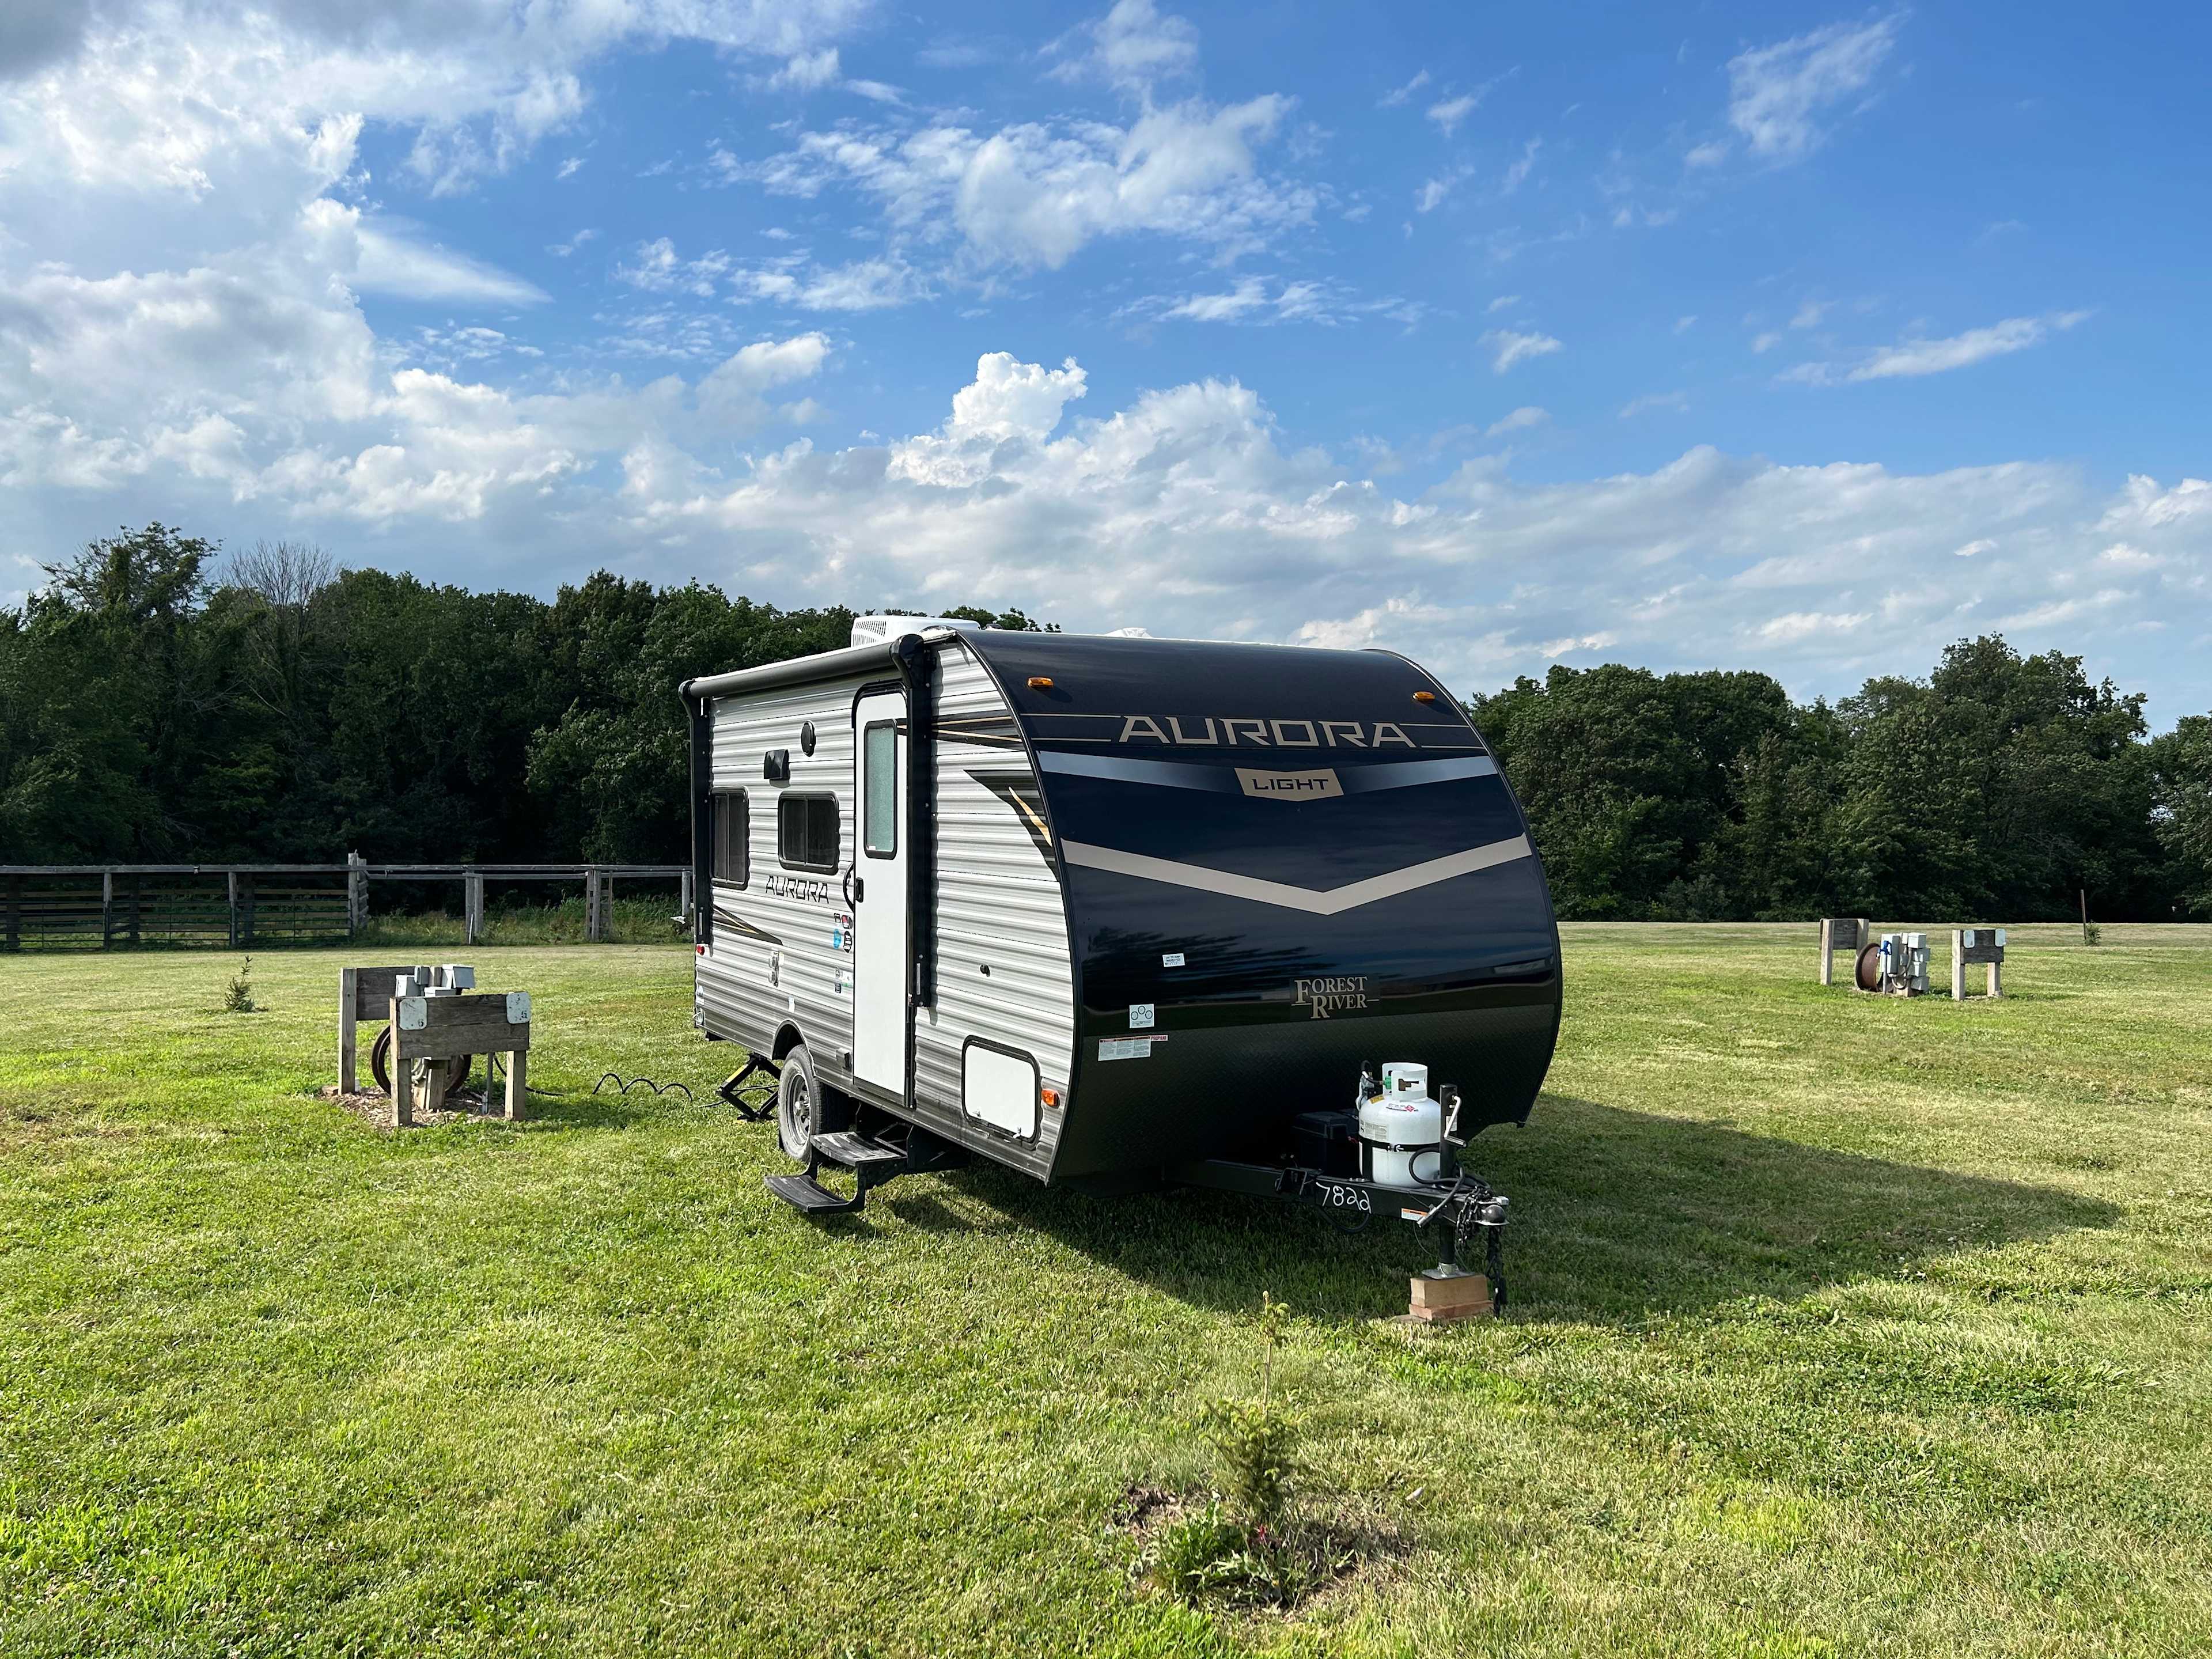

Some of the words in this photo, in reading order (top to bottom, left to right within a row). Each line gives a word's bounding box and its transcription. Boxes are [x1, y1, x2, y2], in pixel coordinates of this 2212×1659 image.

[1119, 715, 1416, 748] AURORA
[1252, 778, 1328, 790] LIGHT
[765, 875, 830, 904] AURORA
[1316, 1181, 1372, 1214] 7822
